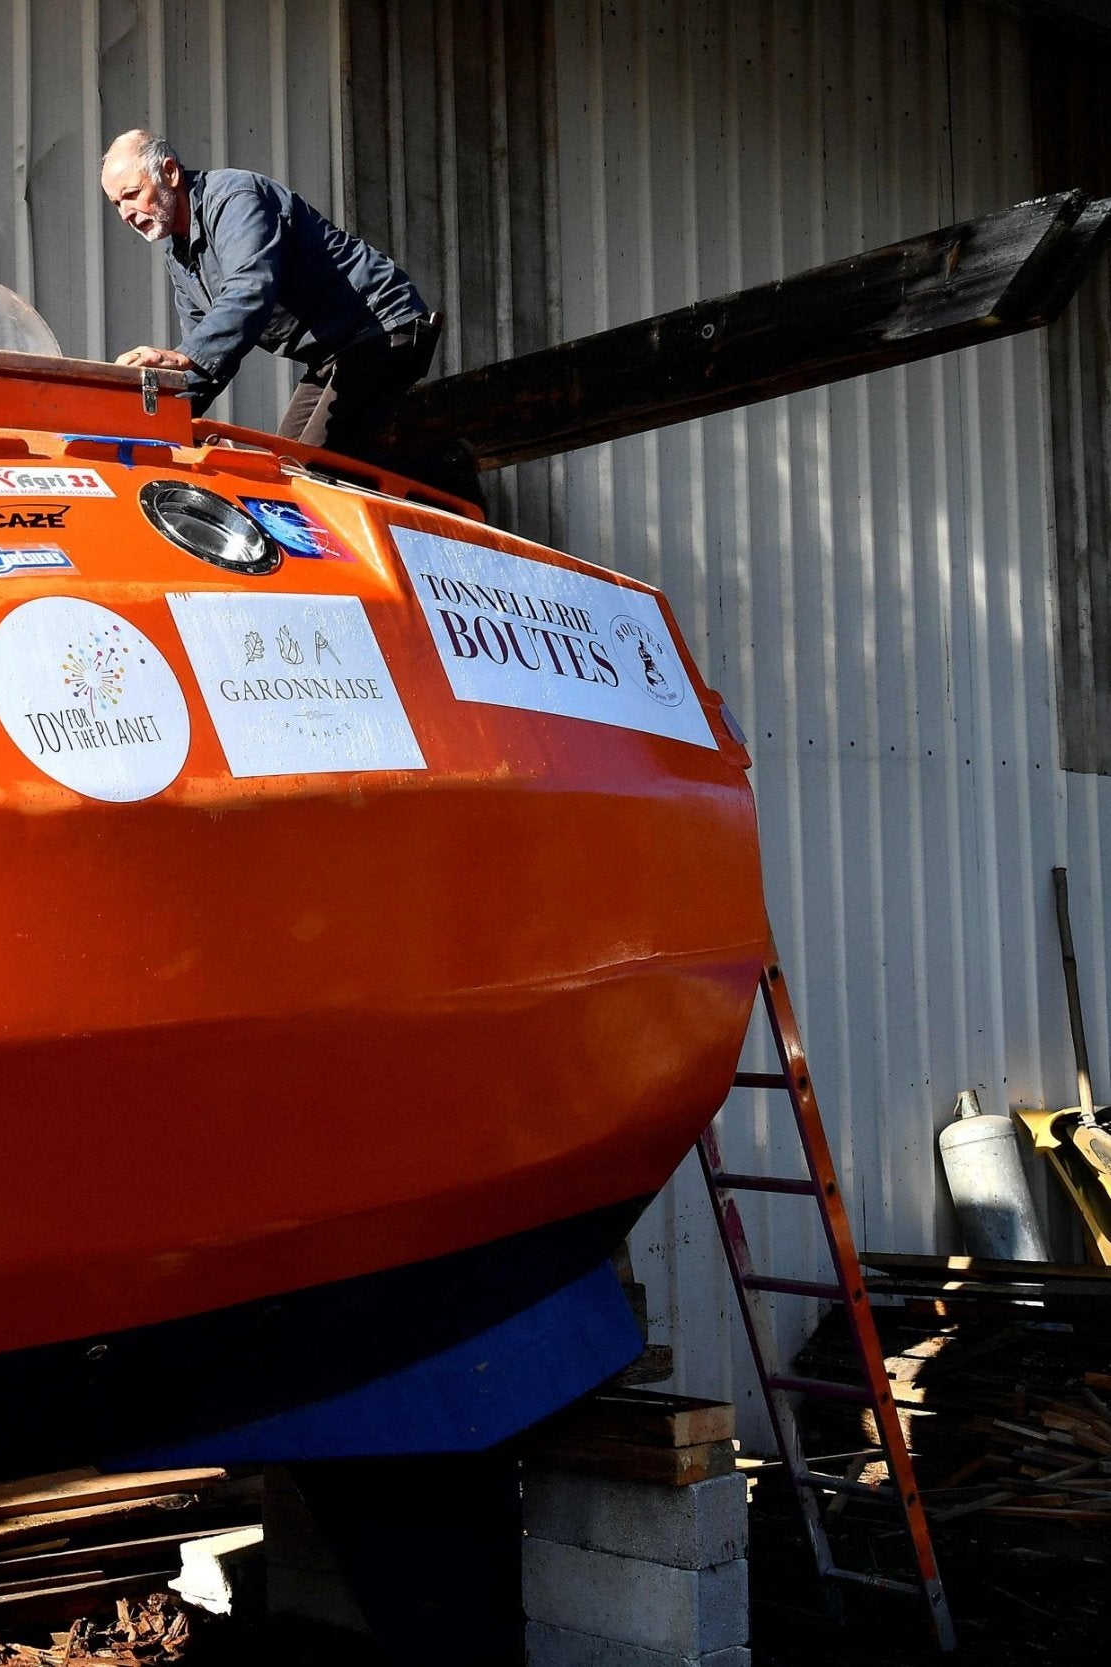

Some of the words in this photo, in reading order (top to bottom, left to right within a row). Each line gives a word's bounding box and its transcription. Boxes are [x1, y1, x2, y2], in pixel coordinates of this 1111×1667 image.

[16, 473, 66, 490] Agri
[67, 474, 99, 488] 33
[419, 573, 599, 635] TONNELLERIE
[435, 608, 620, 688] BOUTES
[220, 678, 383, 701] GARONNAISE
[65, 708, 92, 729] FOR
[94, 715, 162, 747] PLANET
[24, 710, 74, 755] JOY
[72, 728, 100, 749] THE
